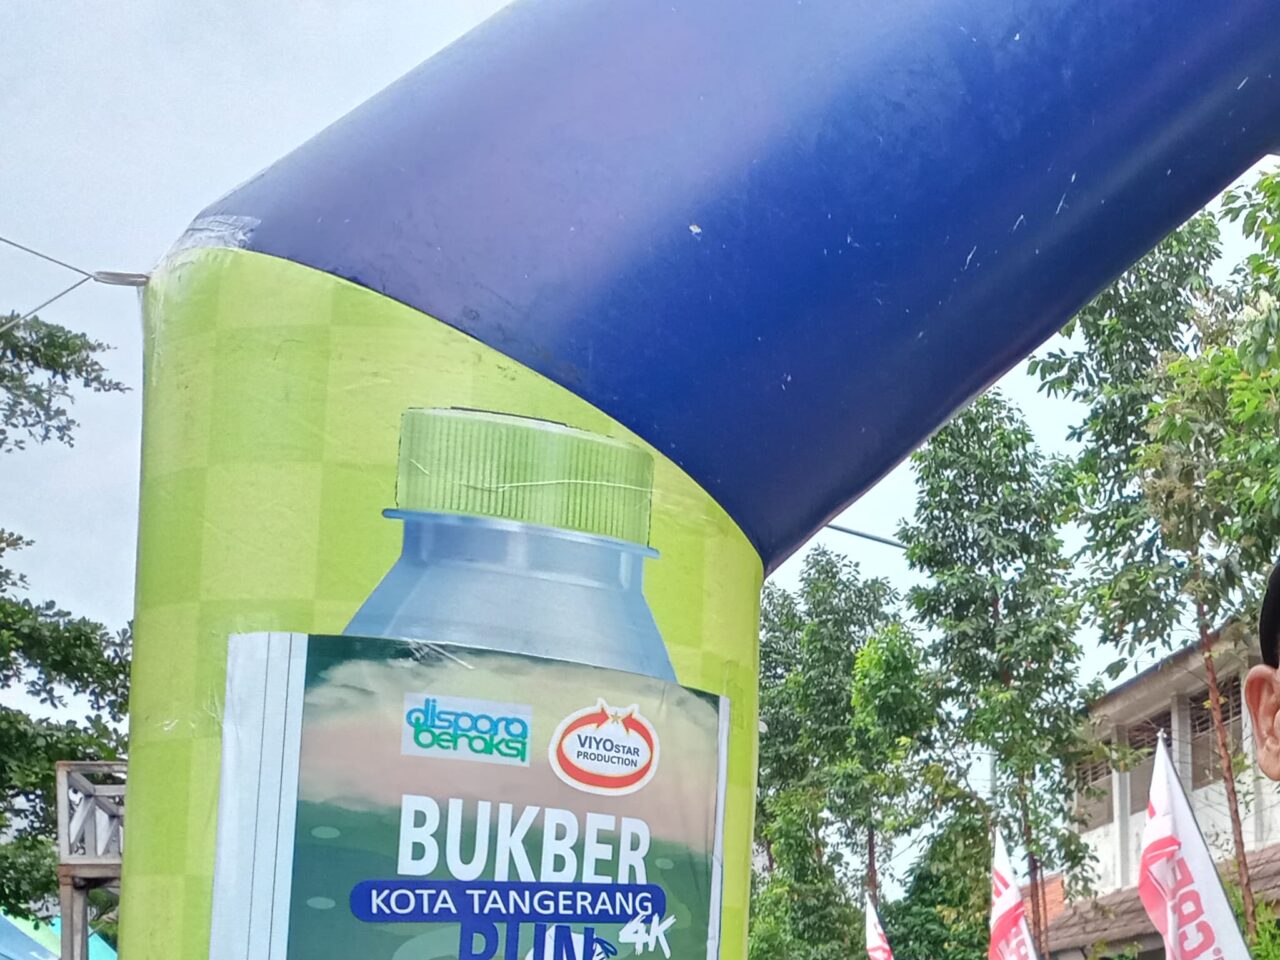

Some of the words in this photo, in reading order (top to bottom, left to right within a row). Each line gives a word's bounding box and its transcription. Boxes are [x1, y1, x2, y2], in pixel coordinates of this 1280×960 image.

[406, 698, 528, 740] dispora
[412, 718, 526, 763] beraksi
[576, 749, 638, 768] PRODUCTION
[396, 795, 652, 885] BUKBER
[370, 889, 457, 916] KOTA
[466, 890, 654, 917] TANGERANG
[619, 913, 678, 960] 4K
